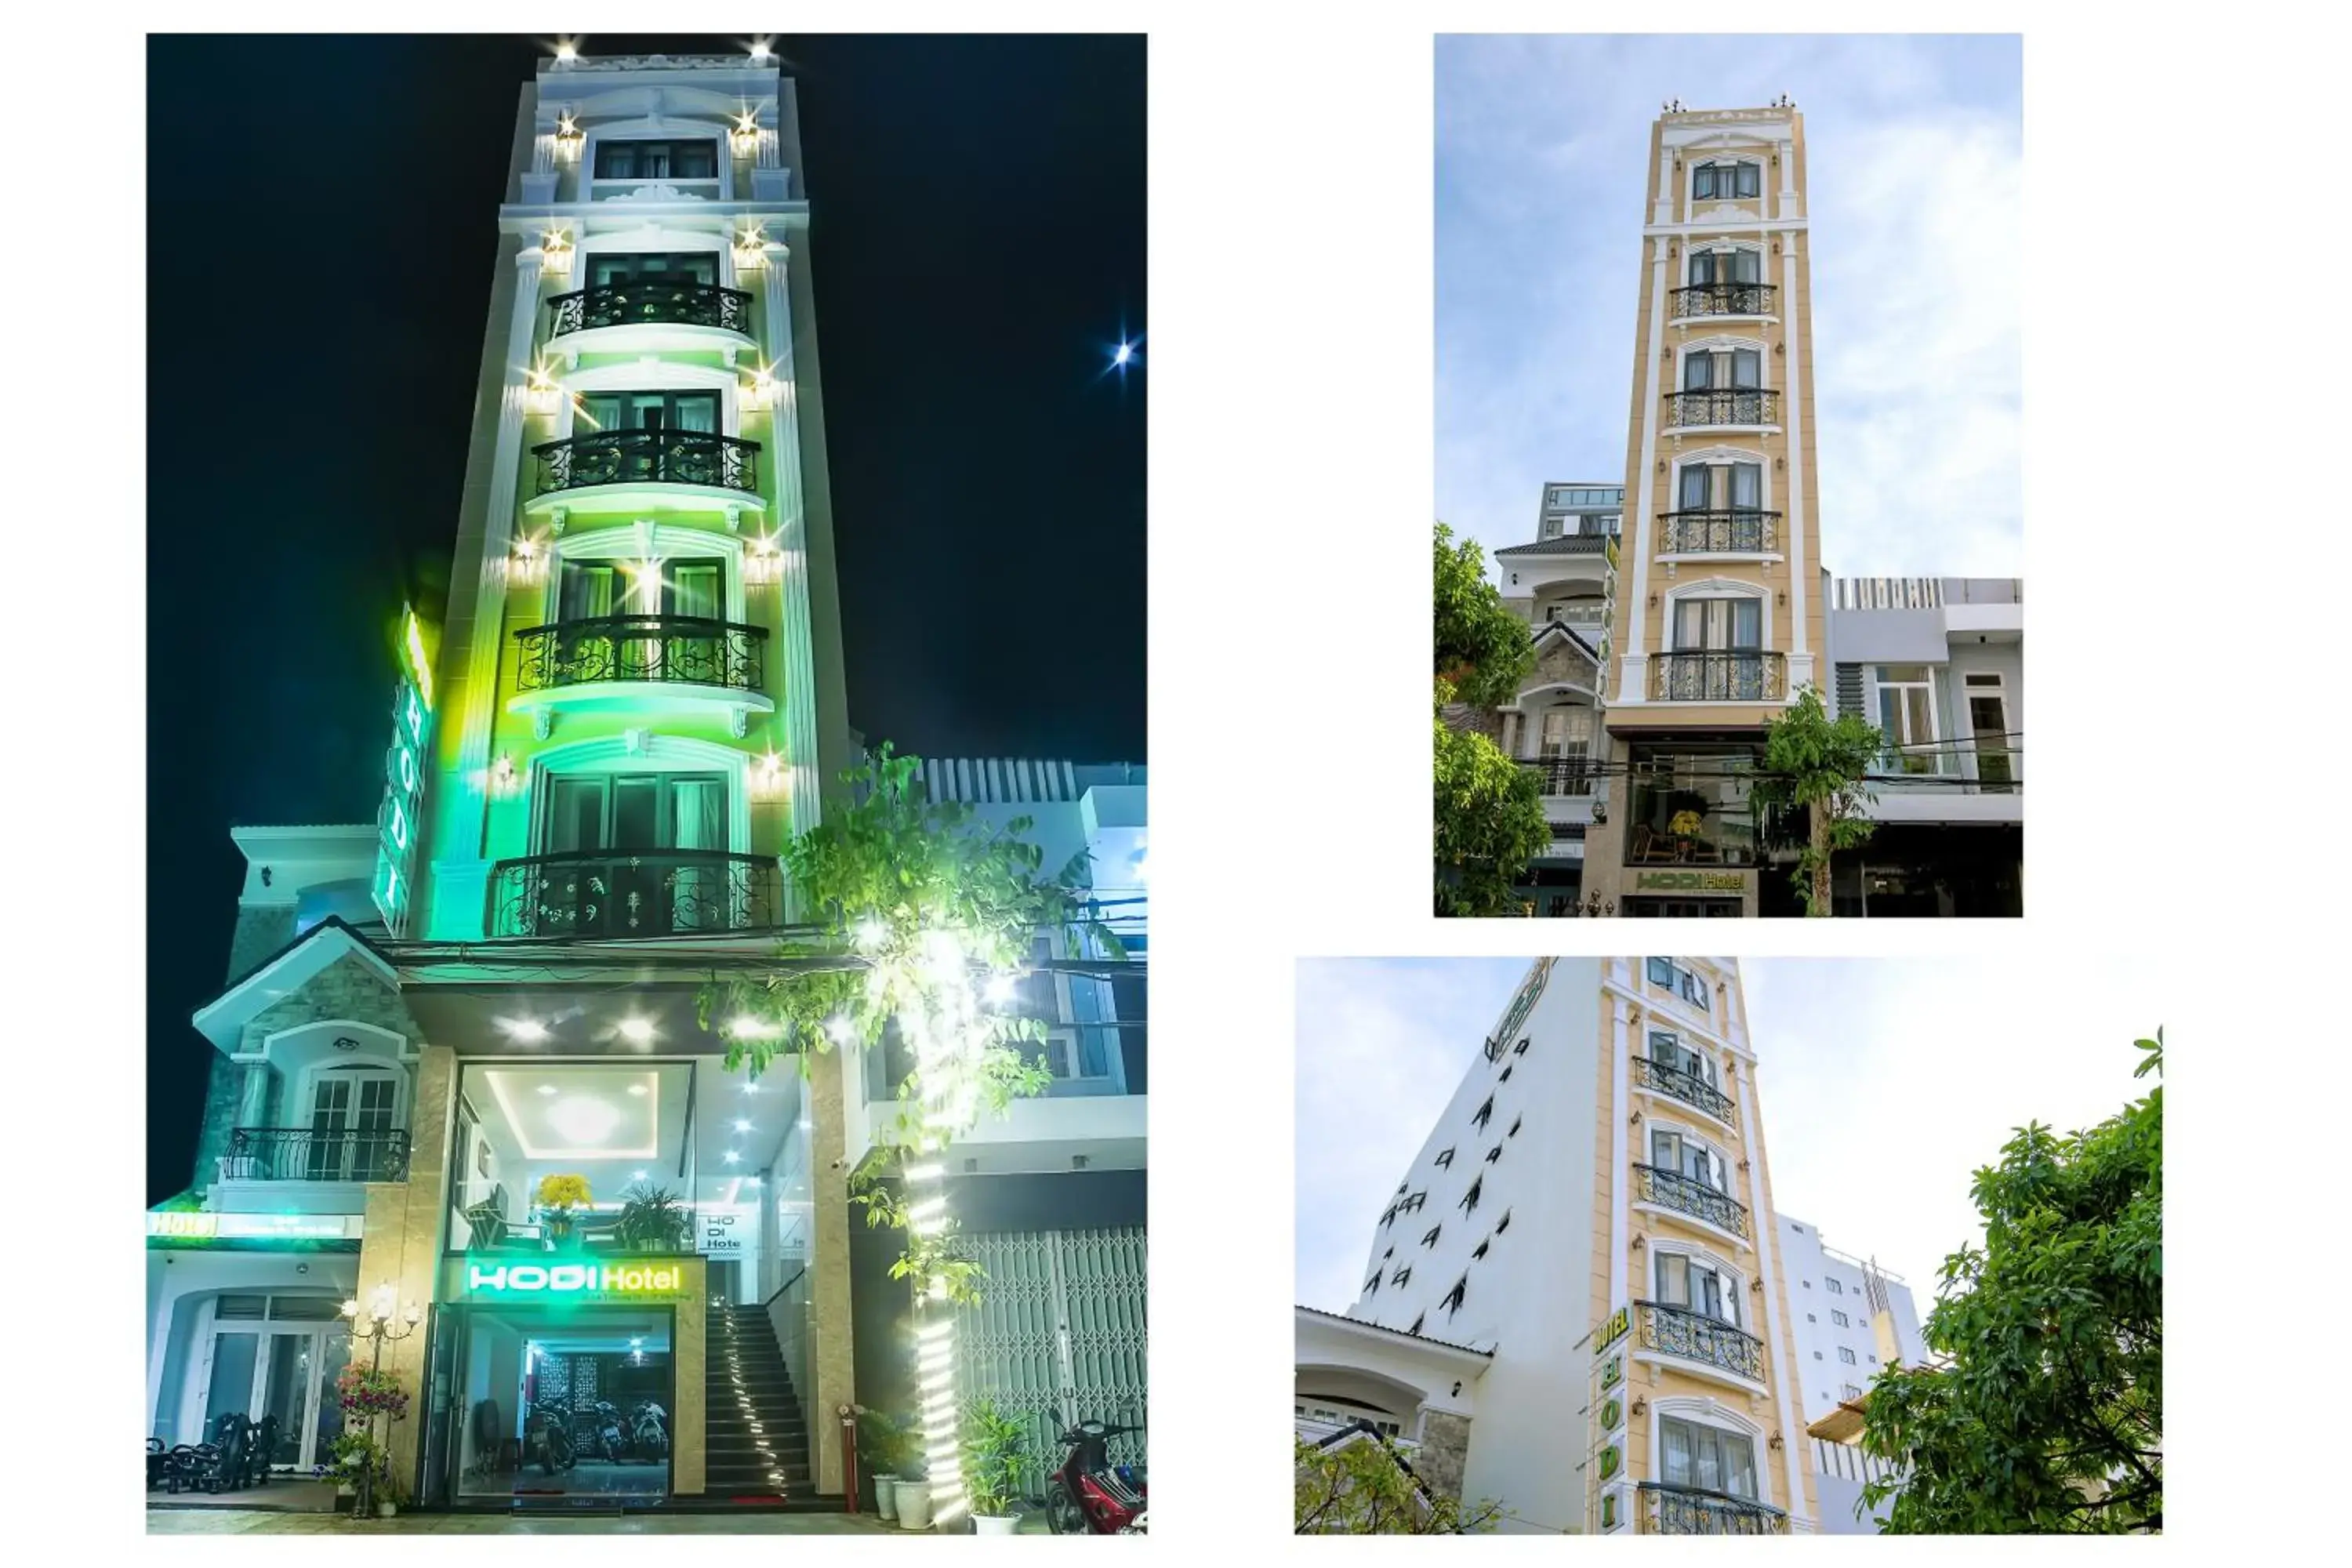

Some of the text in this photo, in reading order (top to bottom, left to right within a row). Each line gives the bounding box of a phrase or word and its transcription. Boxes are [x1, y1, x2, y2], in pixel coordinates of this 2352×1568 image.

[1637, 872, 1745, 890] HODI Hotel
[469, 1264, 680, 1291] HODI Hotel
[1599, 1356, 1621, 1528] HODI
